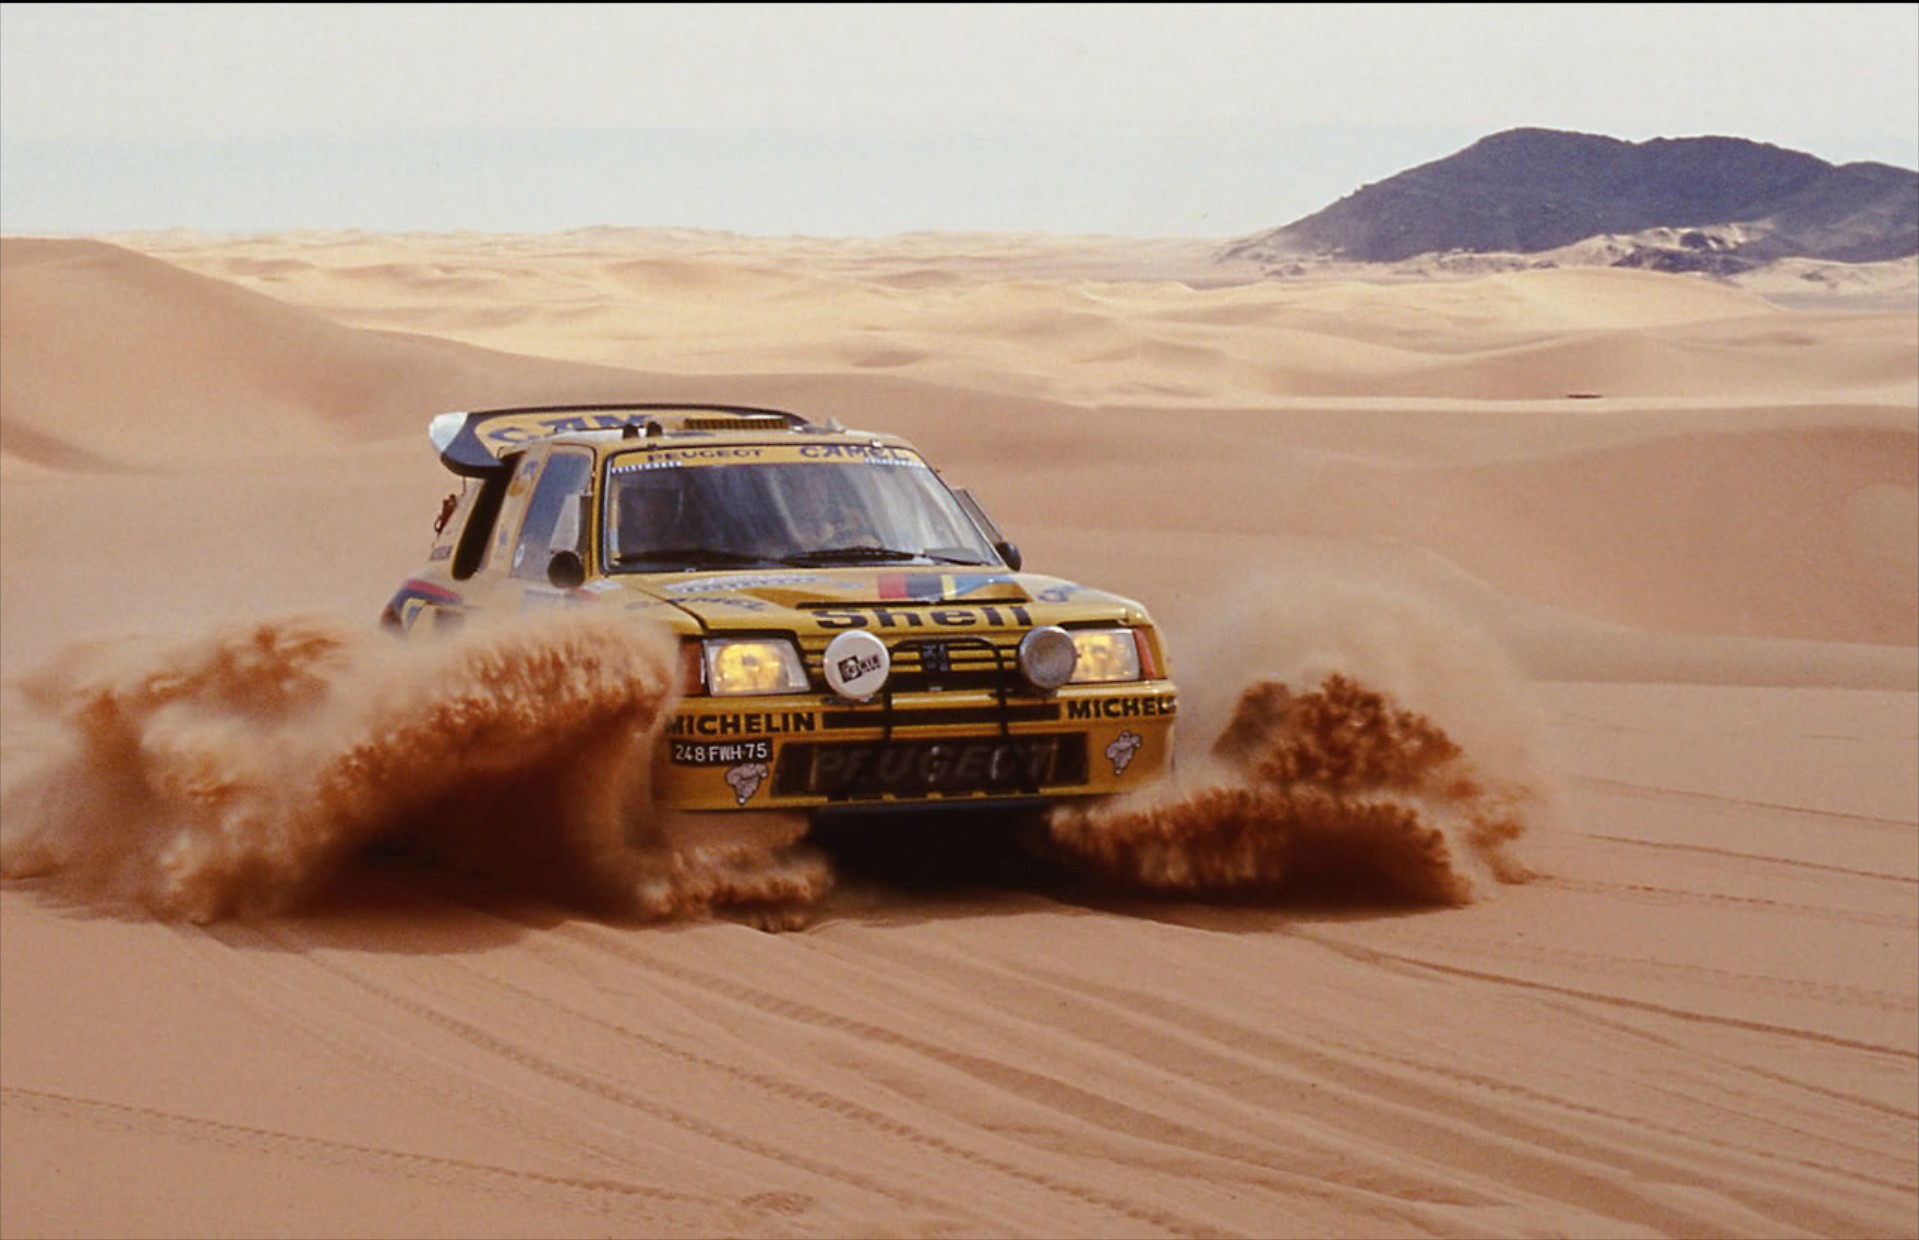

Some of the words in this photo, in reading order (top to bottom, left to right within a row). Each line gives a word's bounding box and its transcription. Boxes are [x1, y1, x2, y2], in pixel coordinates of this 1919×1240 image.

[647, 449, 763, 462] PEUGEOT
[800, 446, 911, 461] CAMEL
[811, 606, 1032, 629] Shell
[676, 745, 705, 761] 248
[745, 743, 767, 758] 75
